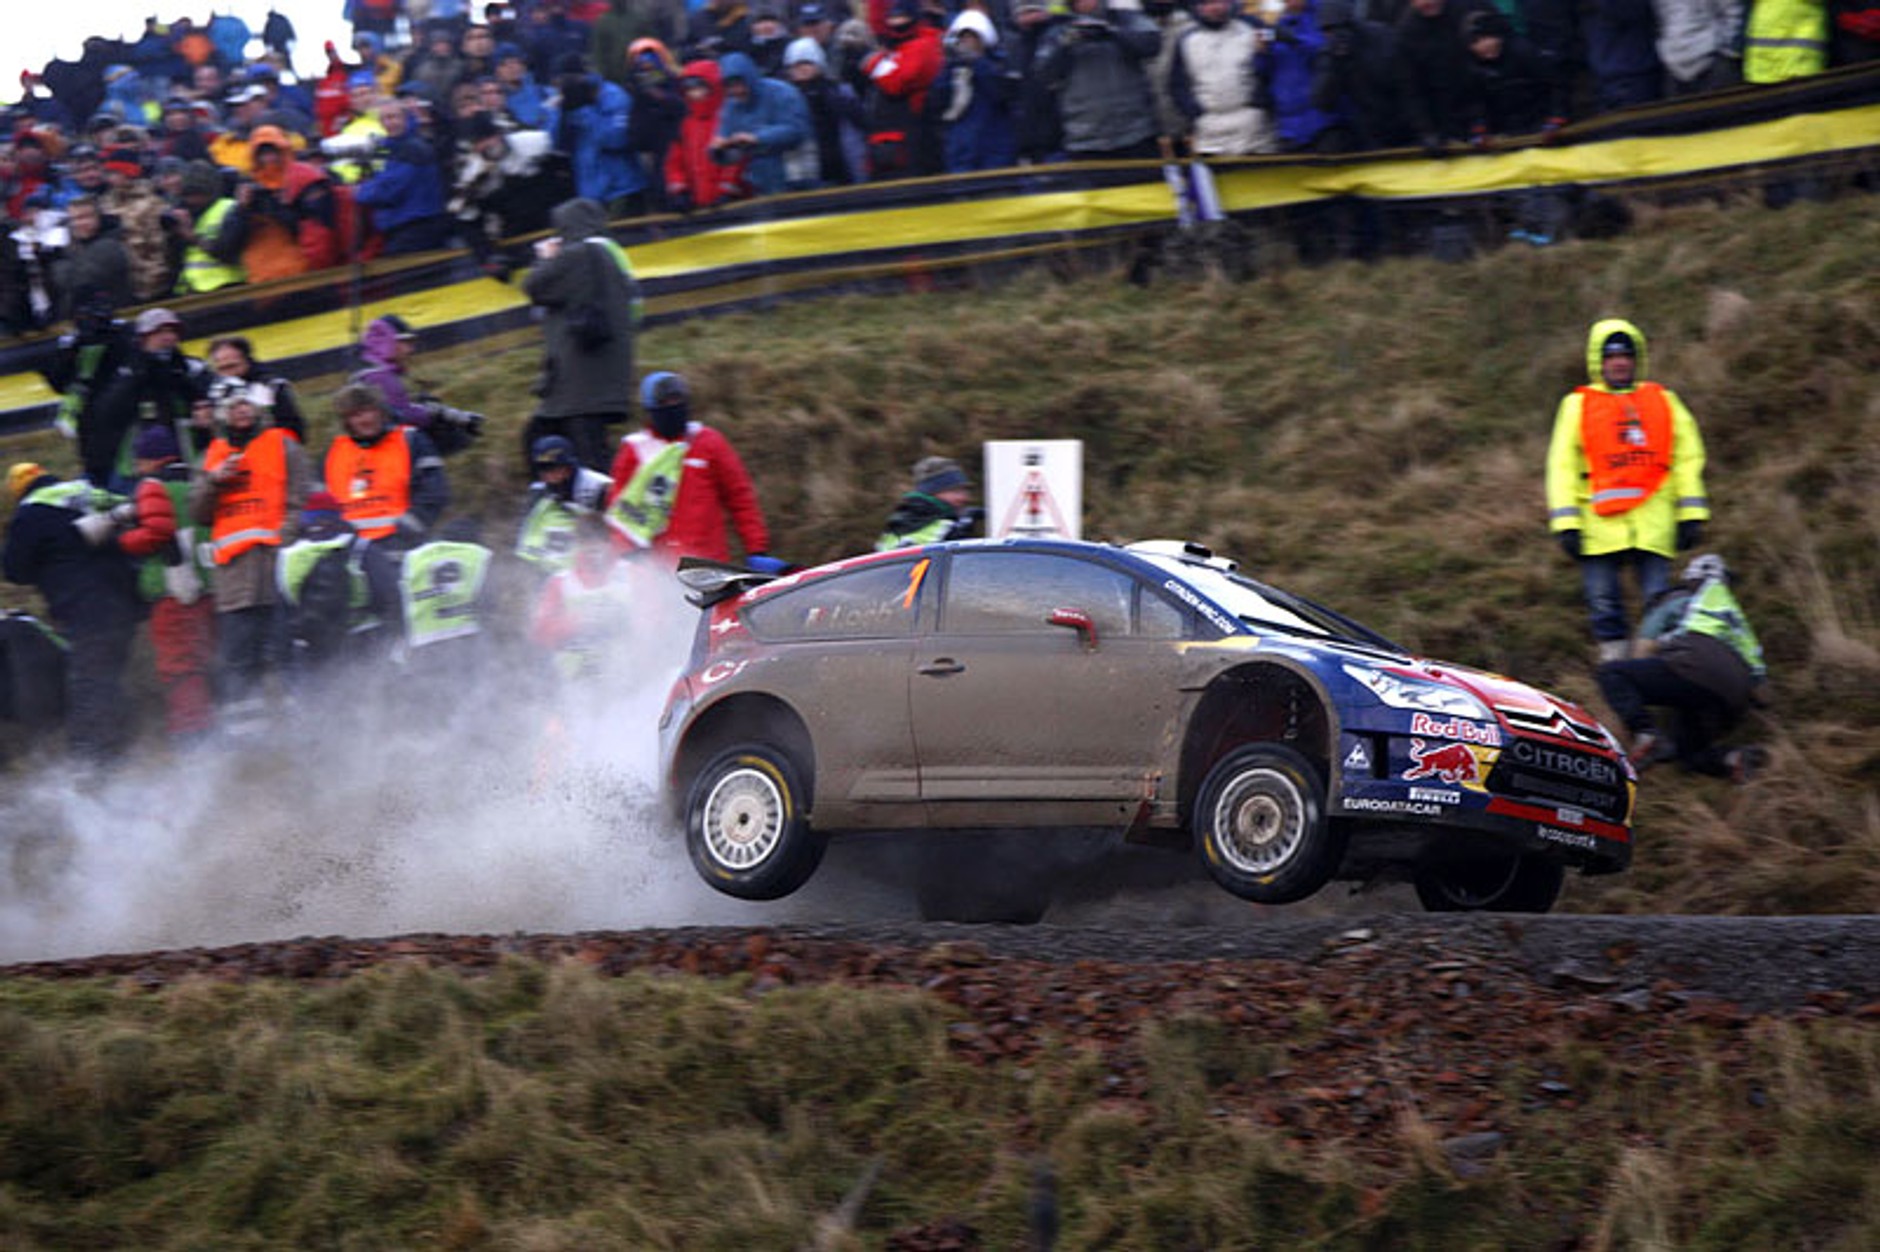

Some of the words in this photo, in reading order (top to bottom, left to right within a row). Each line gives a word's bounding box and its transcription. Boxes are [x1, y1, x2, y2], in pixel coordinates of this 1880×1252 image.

[902, 558, 931, 609] 1
[1410, 712, 1459, 738] Red
[1460, 721, 1501, 746] Bull
